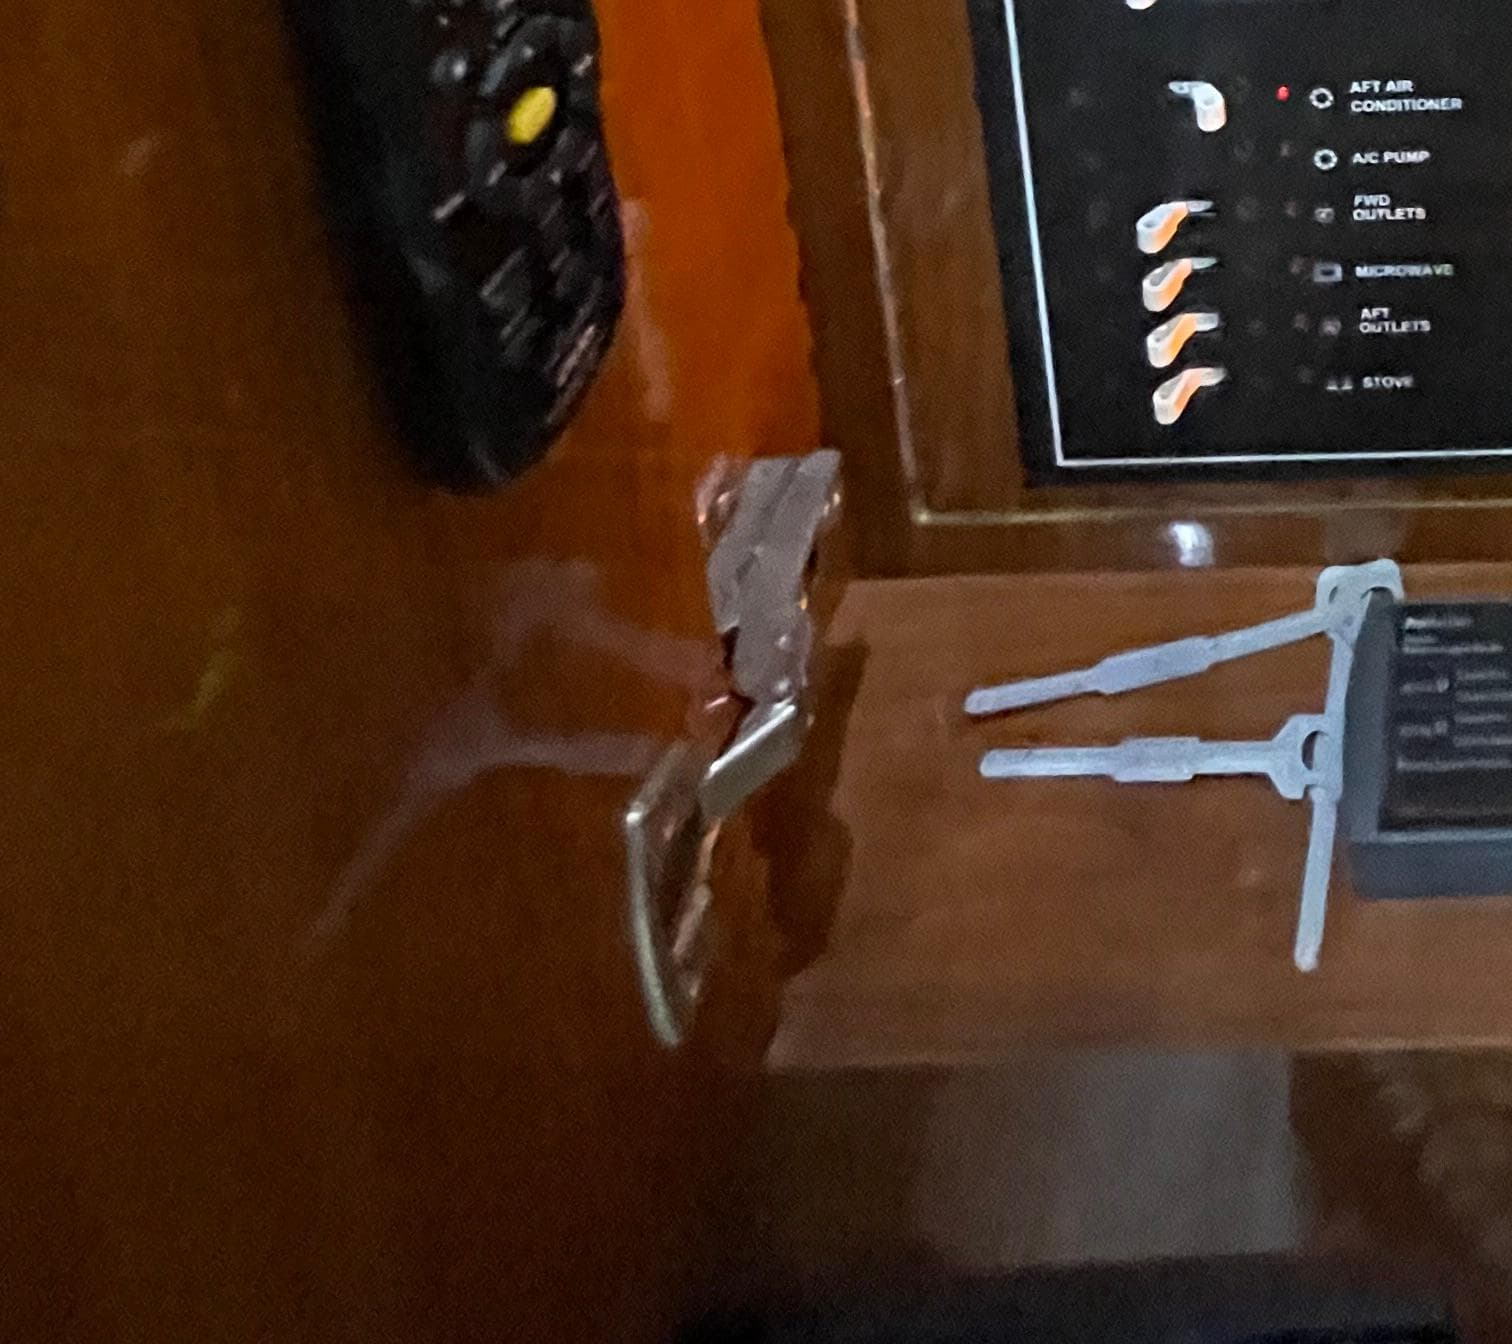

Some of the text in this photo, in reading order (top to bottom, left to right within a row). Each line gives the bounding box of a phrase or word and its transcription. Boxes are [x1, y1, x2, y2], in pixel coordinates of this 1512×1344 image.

[1350, 80, 1414, 94] AFT AIR
[1350, 98, 1462, 113] CONDITIONER
[1383, 150, 1431, 164] PUMP
[1354, 194, 1391, 207] FWD
[1353, 207, 1426, 221] OUTLETS
[1355, 263, 1454, 278] MICROWAVE
[1360, 308, 1390, 320] AFT
[1359, 320, 1431, 333] OUTLETS
[1362, 376, 1414, 389] STOVE
